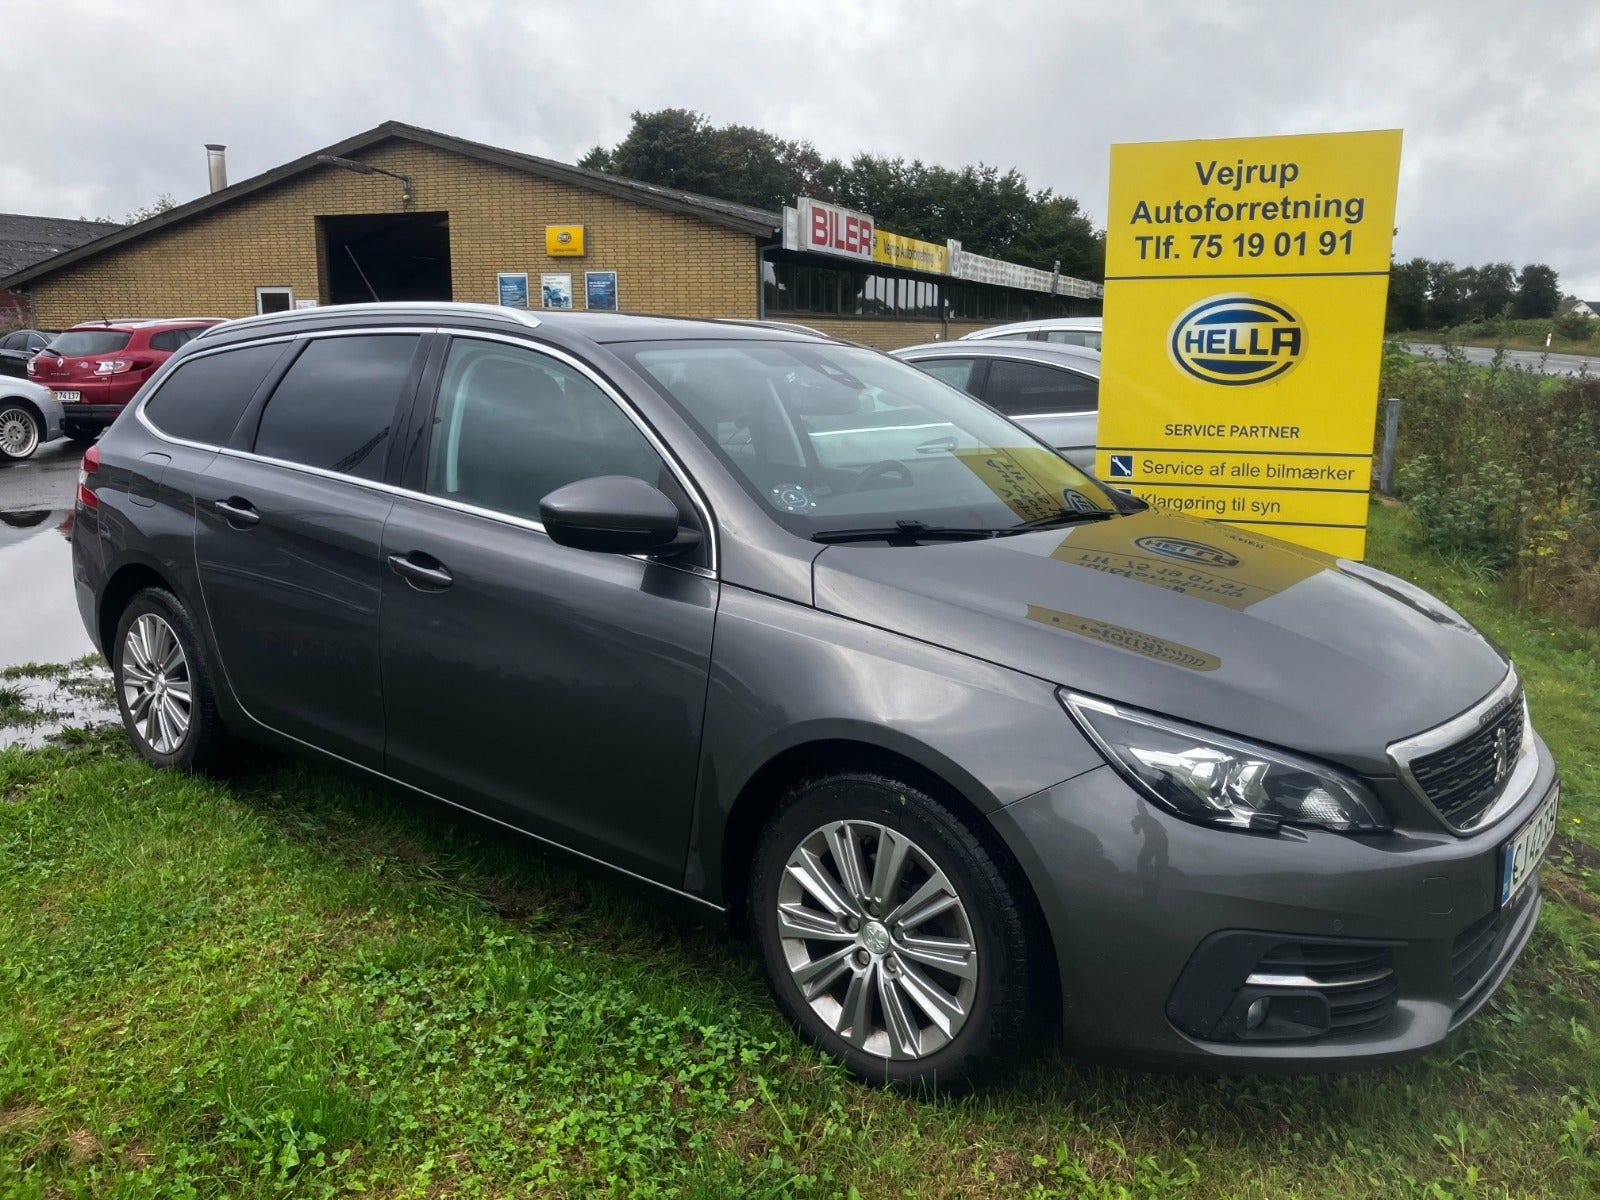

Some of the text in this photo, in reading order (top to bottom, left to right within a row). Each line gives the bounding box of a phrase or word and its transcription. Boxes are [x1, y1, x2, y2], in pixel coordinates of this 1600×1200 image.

[1195, 159, 1299, 191] Vejrup
[1130, 193, 1365, 224] Autoforretning
[811, 206, 872, 256] BILER
[1135, 230, 1353, 260] Tlf. 75 19 01 91
[1185, 327, 1301, 356] HELLA
[1164, 423, 1300, 439] SERVICE PARTNER
[1142, 459, 1355, 480] Service af alle bilmærker
[1141, 493, 1281, 516] Klargøring til syn
